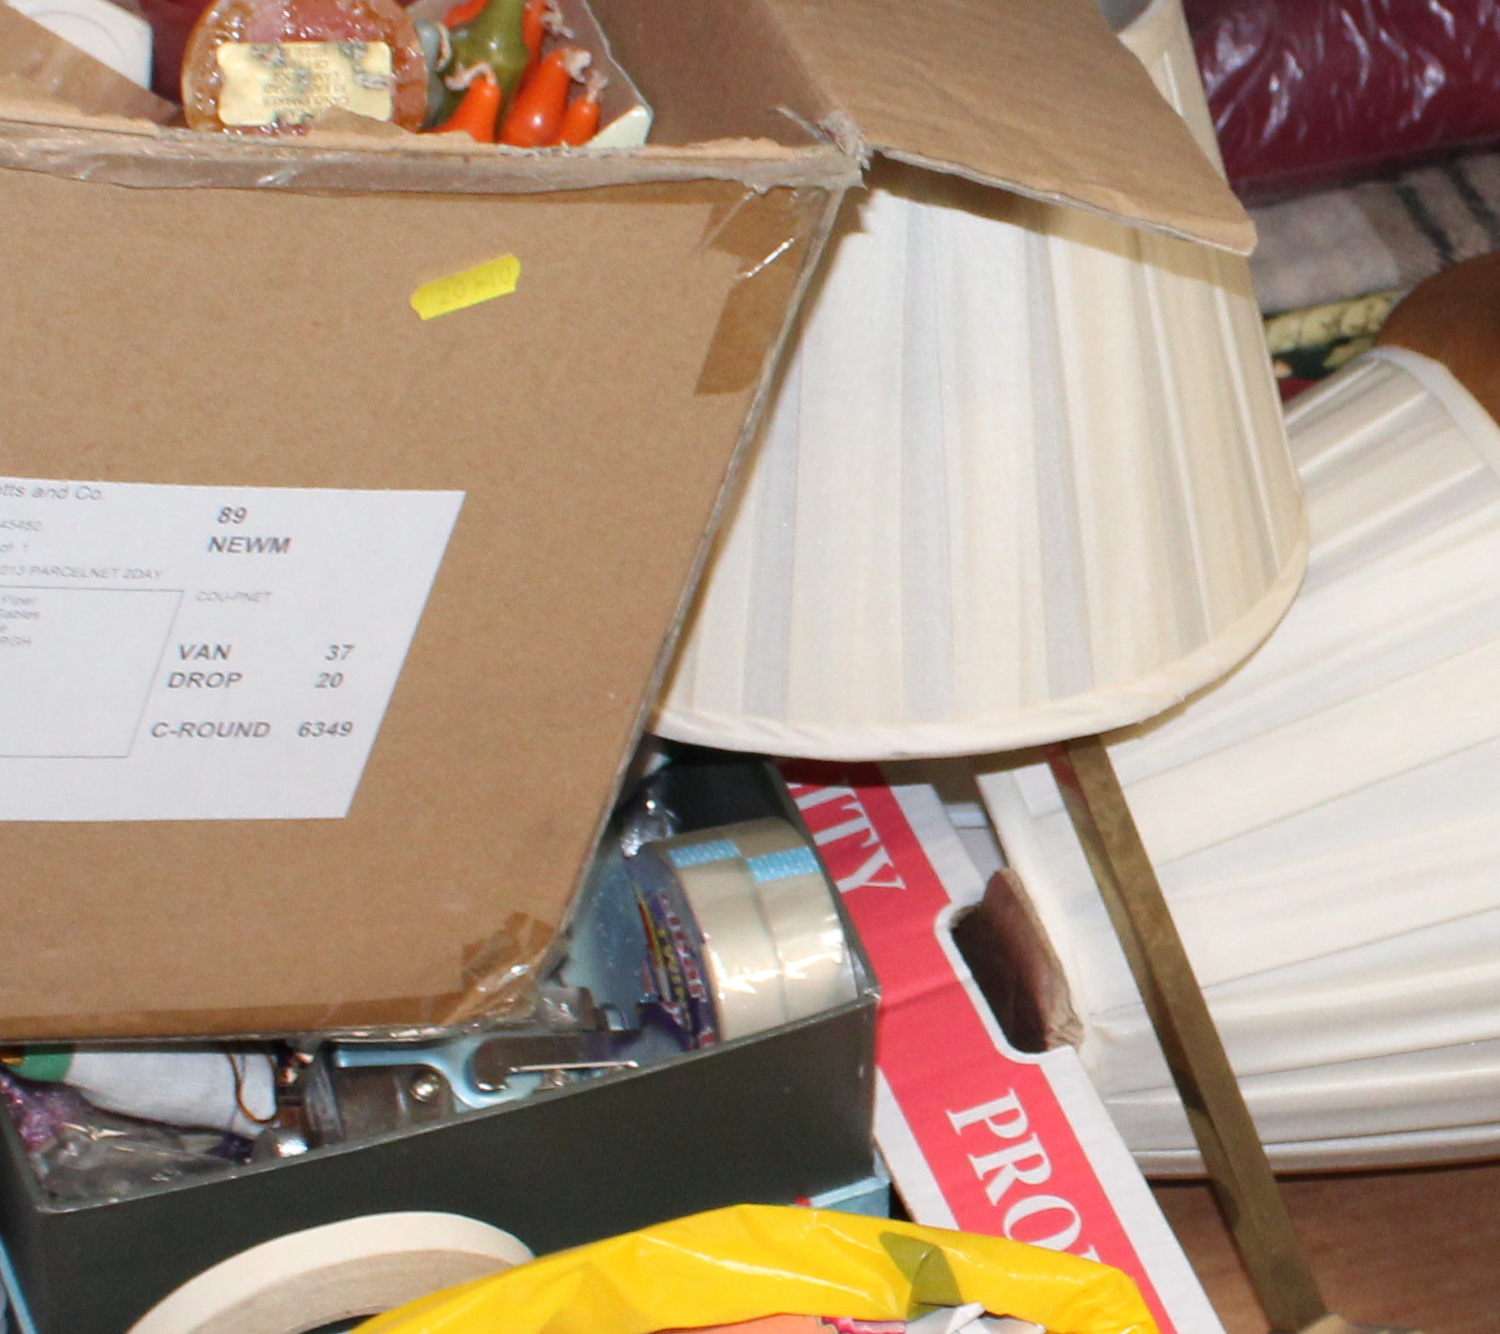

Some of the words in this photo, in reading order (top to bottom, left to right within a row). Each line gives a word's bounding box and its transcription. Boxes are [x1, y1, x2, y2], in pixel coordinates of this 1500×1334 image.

[31, 483, 68, 501] and
[216, 505, 248, 525] 89
[207, 535, 292, 555] NEWM
[28, 565, 119, 580] PARCELNET
[177, 643, 233, 662] VAN
[324, 644, 356, 662] 37
[166, 671, 244, 690] DROP
[314, 671, 345, 690] 20
[150, 721, 272, 740] C-ROUND
[297, 721, 355, 740] 6349
[786, 782, 908, 895] ITY
[945, 1086, 1103, 1265] PRO
